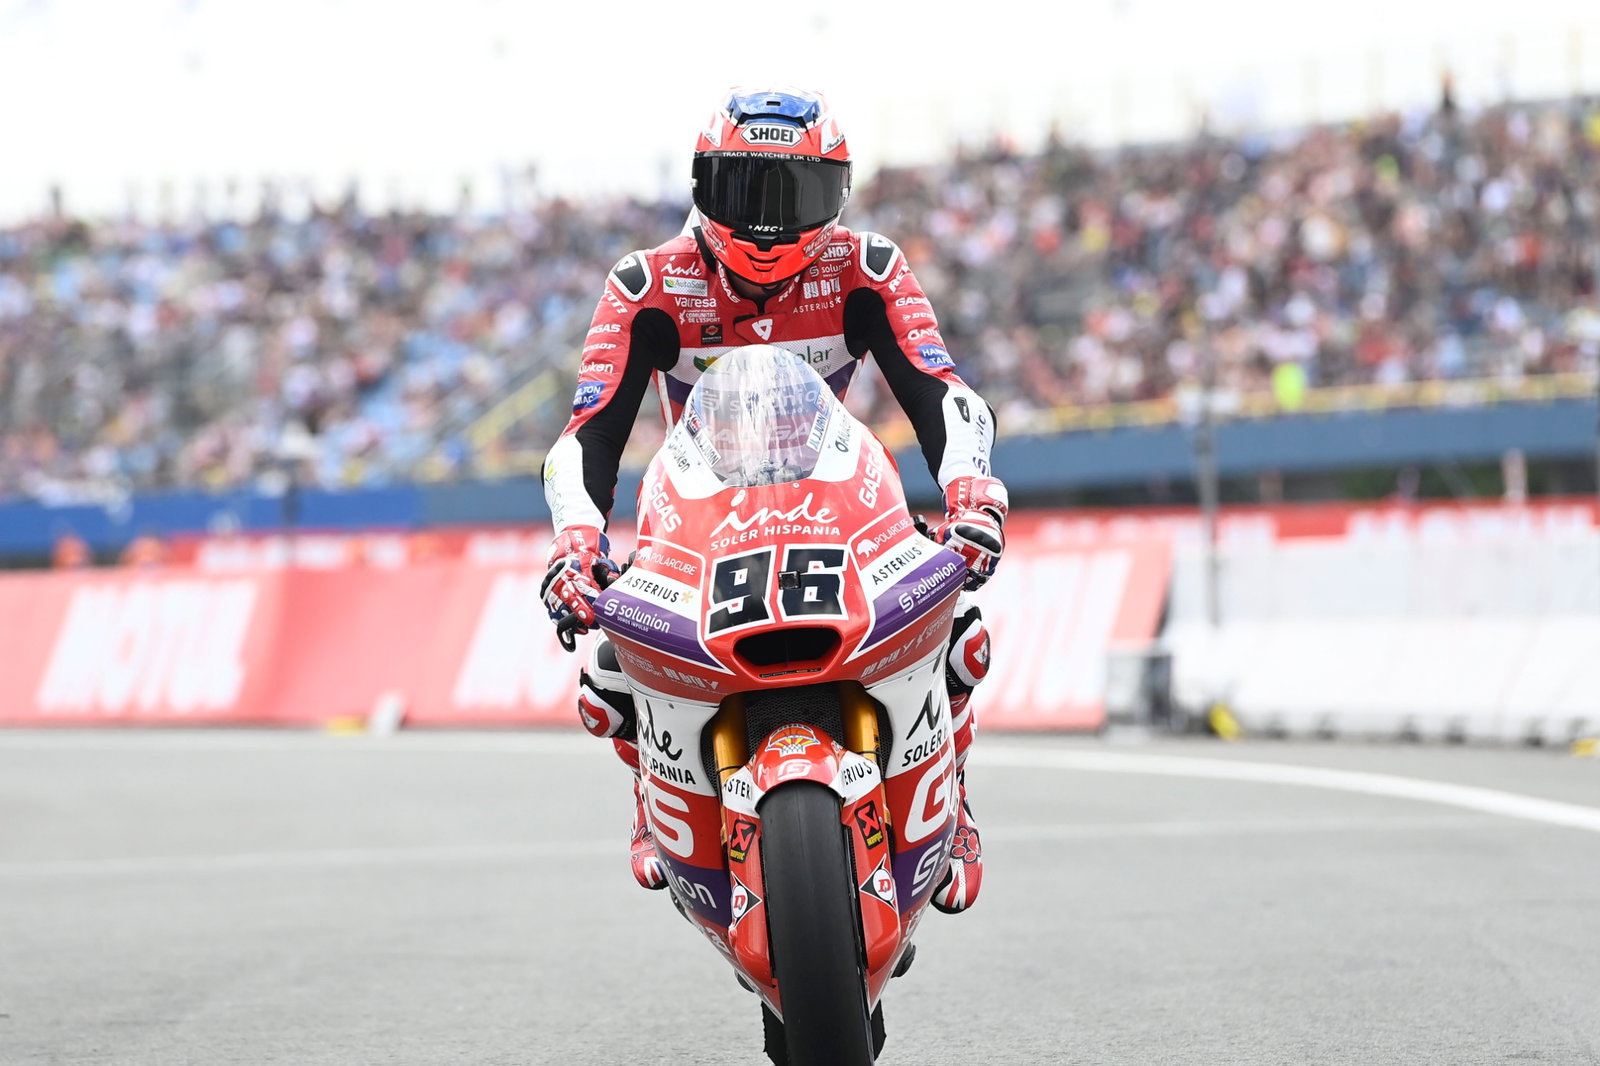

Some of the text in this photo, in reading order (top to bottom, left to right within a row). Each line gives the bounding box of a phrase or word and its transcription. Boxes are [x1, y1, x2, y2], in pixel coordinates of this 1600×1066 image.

[750, 127, 794, 143] SHOEI
[750, 151, 791, 160] WATCHES
[753, 224, 779, 233] NSC
[660, 255, 702, 277] inde
[793, 300, 835, 315] ASTERIUS
[708, 489, 839, 538] inde
[710, 524, 841, 551] SOLER HISPANIA
[874, 517, 911, 548] POLARCUBE
[651, 552, 698, 576] POLARCUBE
[872, 546, 922, 586] ASTERIUS
[623, 575, 680, 604] ASTERIUS
[704, 543, 850, 638] 96
[912, 561, 957, 600] solunion
[618, 603, 671, 634] solunion
[902, 729, 943, 767] SOLER
